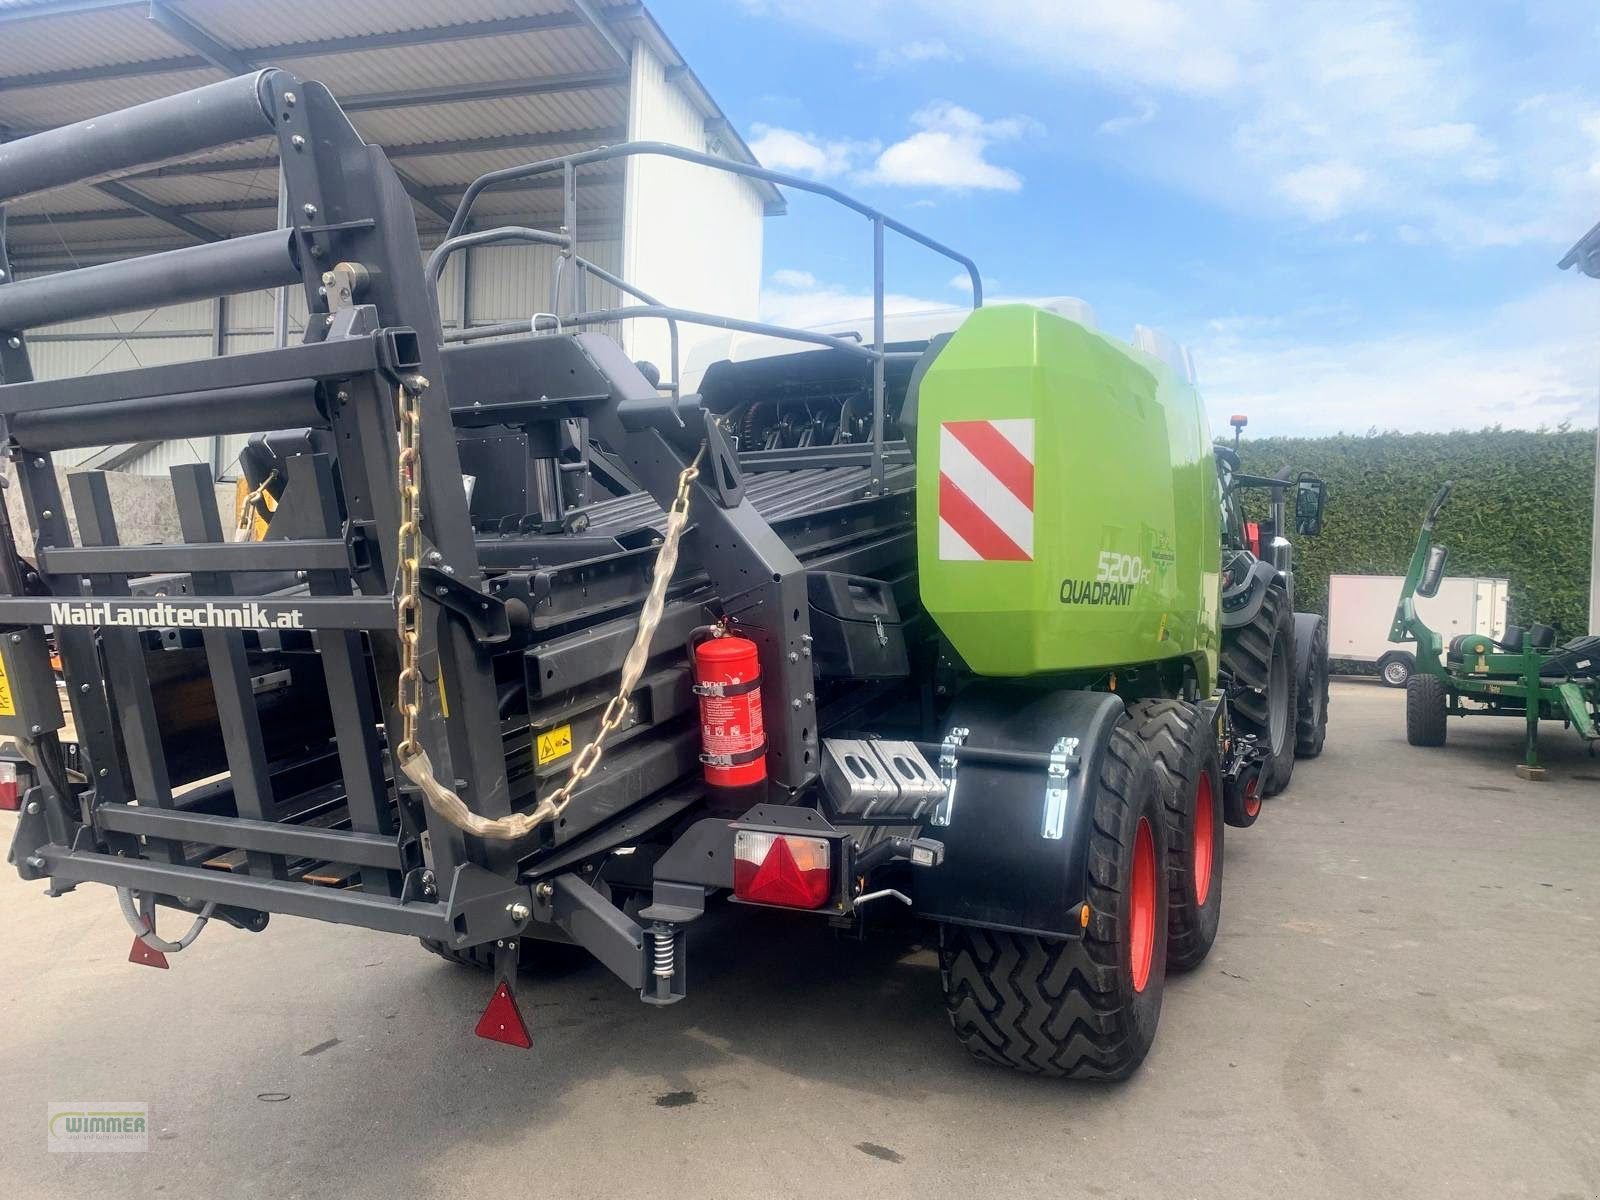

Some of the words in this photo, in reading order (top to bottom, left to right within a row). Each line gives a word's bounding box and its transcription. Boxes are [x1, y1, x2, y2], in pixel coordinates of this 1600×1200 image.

[1097, 551, 1142, 584] 5200
[1060, 579, 1134, 606] QUADRANT
[51, 603, 303, 629] MairLandtechnik.at
